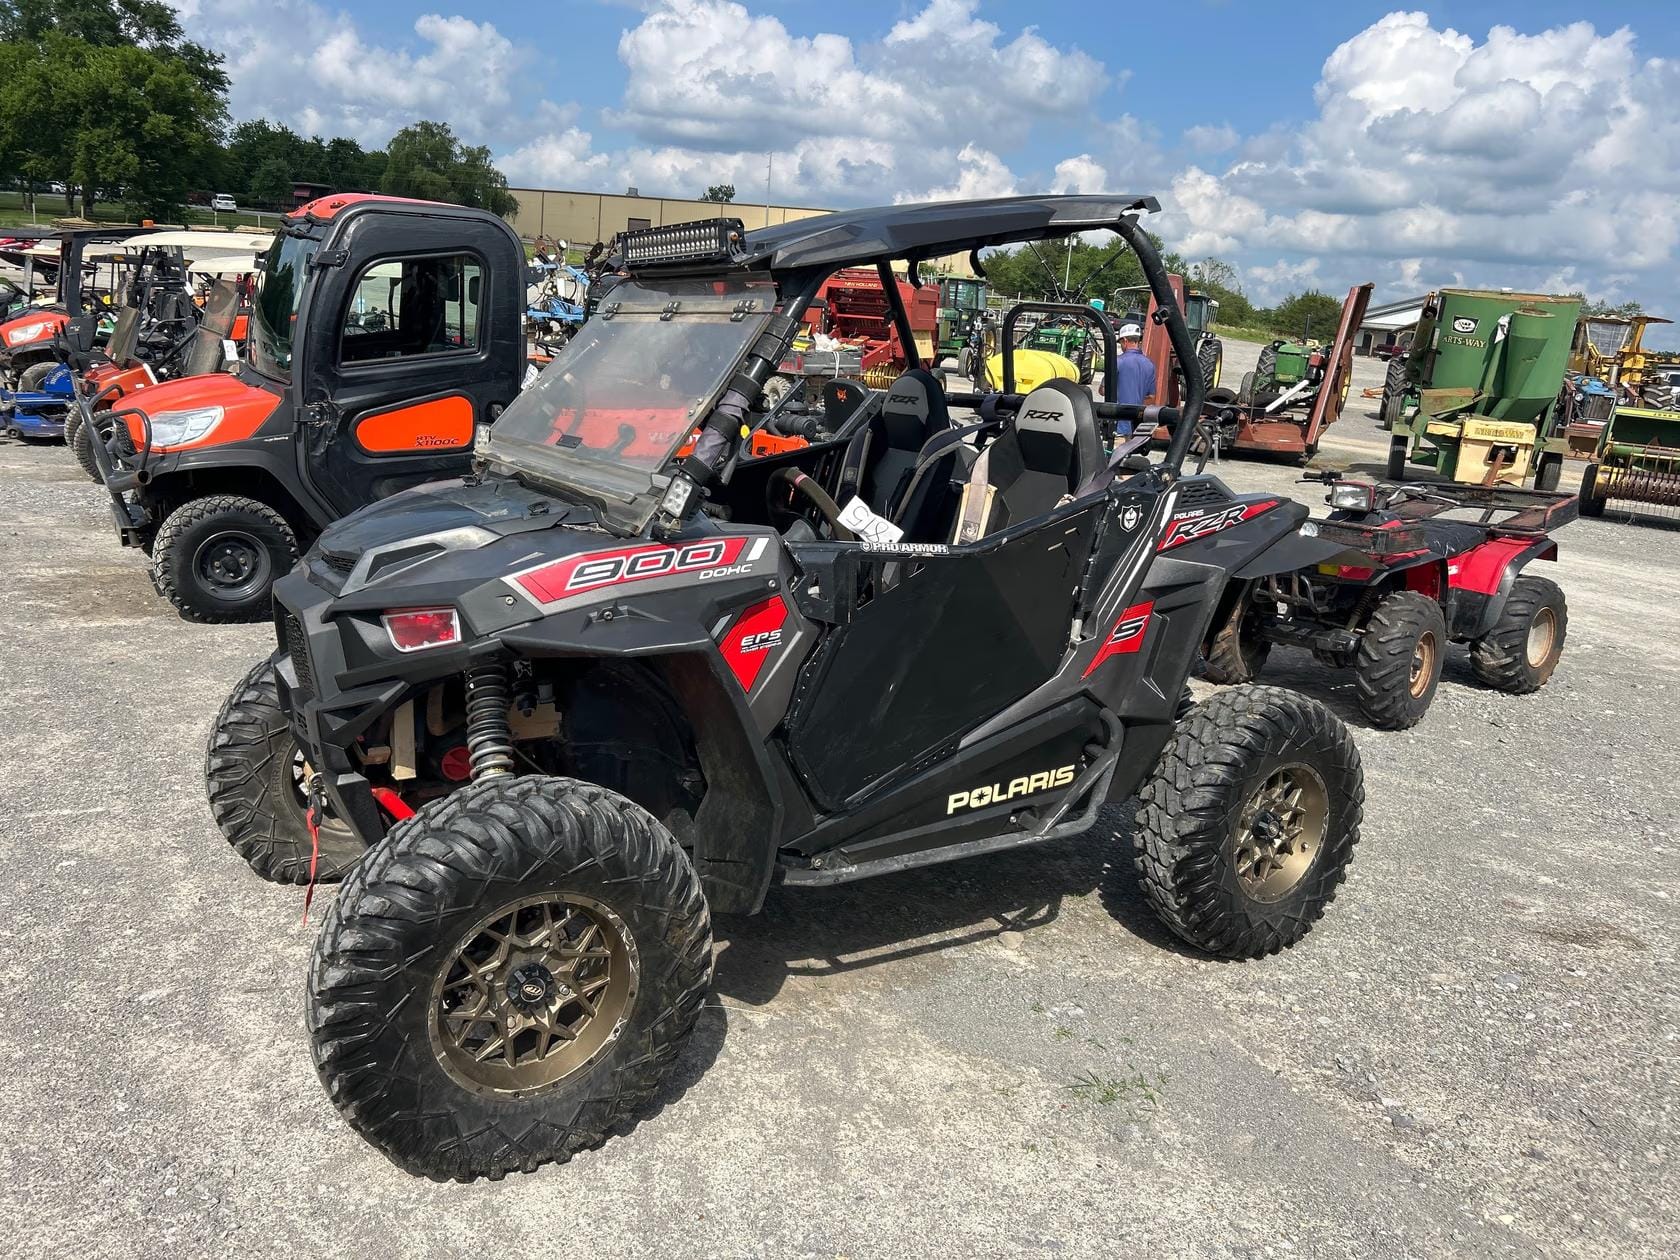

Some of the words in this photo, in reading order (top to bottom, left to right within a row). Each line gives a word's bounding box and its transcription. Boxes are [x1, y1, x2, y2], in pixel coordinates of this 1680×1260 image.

[888, 394, 919, 405] RZR
[1024, 409, 1064, 422] RZR
[1173, 509, 1205, 520] POLARIS
[1163, 504, 1248, 549] RZR
[872, 543, 900, 553] PRO
[901, 543, 949, 554] ARMOR
[565, 541, 726, 591] 900
[699, 563, 753, 580] DOHC
[741, 629, 783, 646] EPS
[1107, 615, 1150, 645] S
[946, 764, 1076, 815] POLARIS
